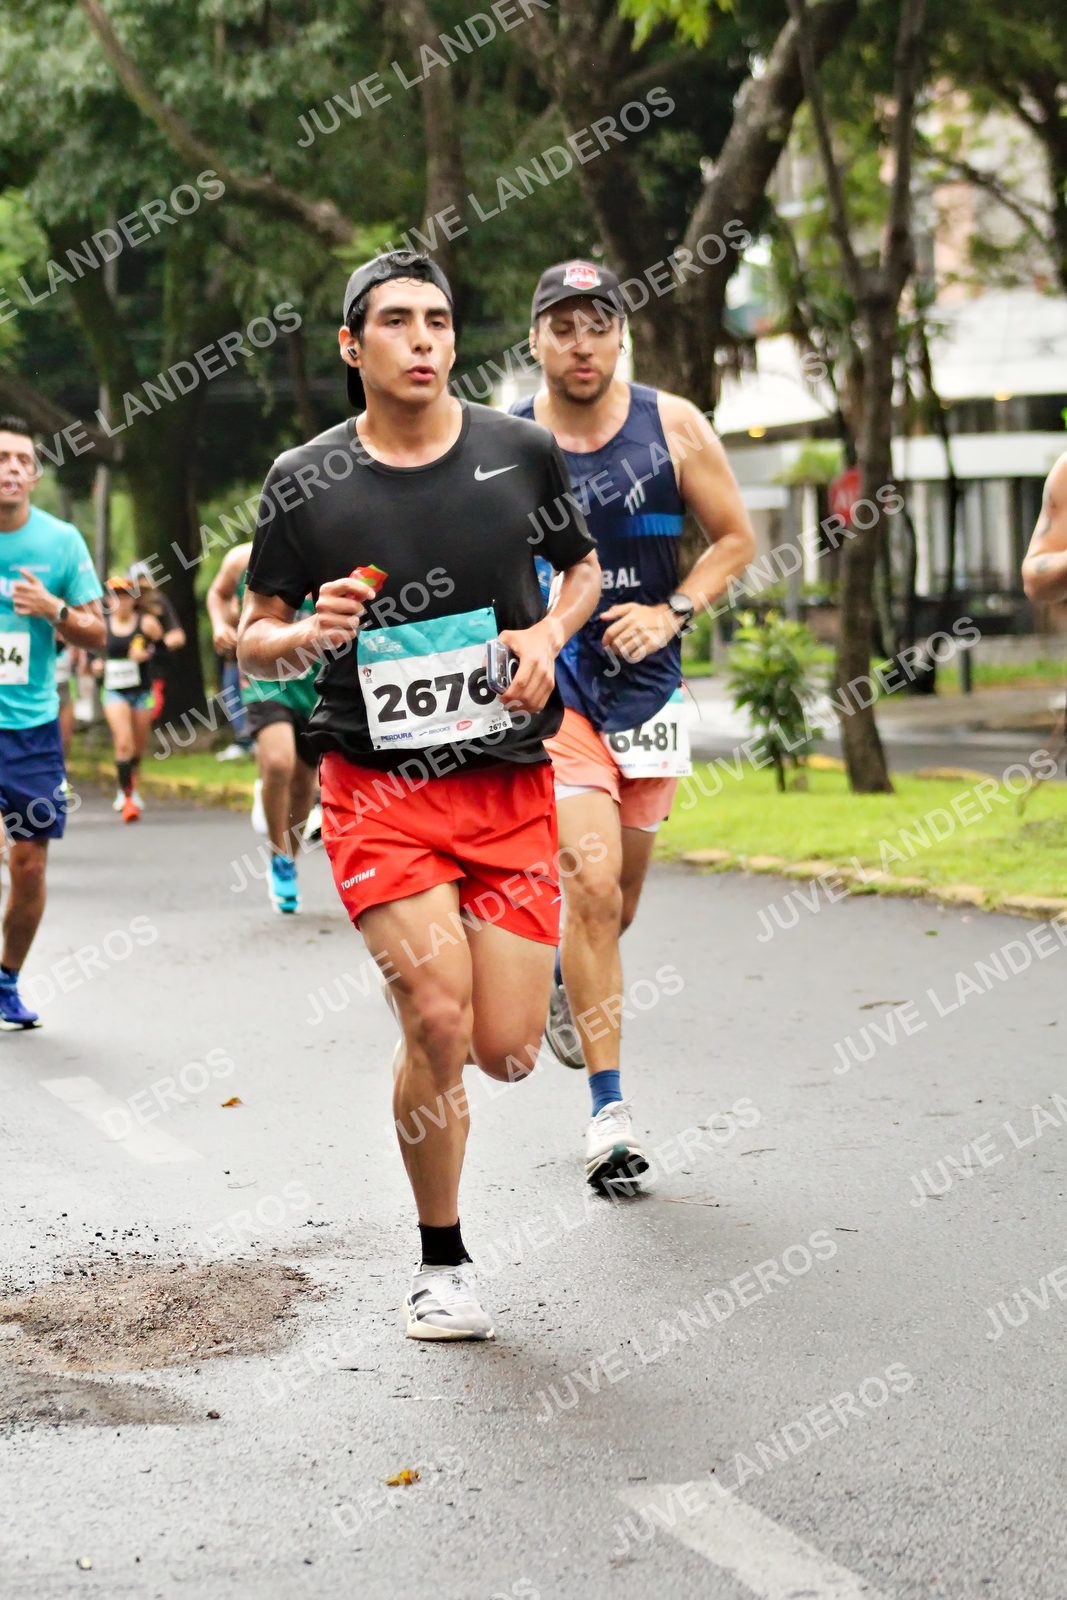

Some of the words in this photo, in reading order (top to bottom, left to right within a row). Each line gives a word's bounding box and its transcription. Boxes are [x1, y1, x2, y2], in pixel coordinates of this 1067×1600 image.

[373, 667, 497, 723] 2676
[380, 732, 413, 741] PERDURA
[609, 722, 677, 753] 6481
